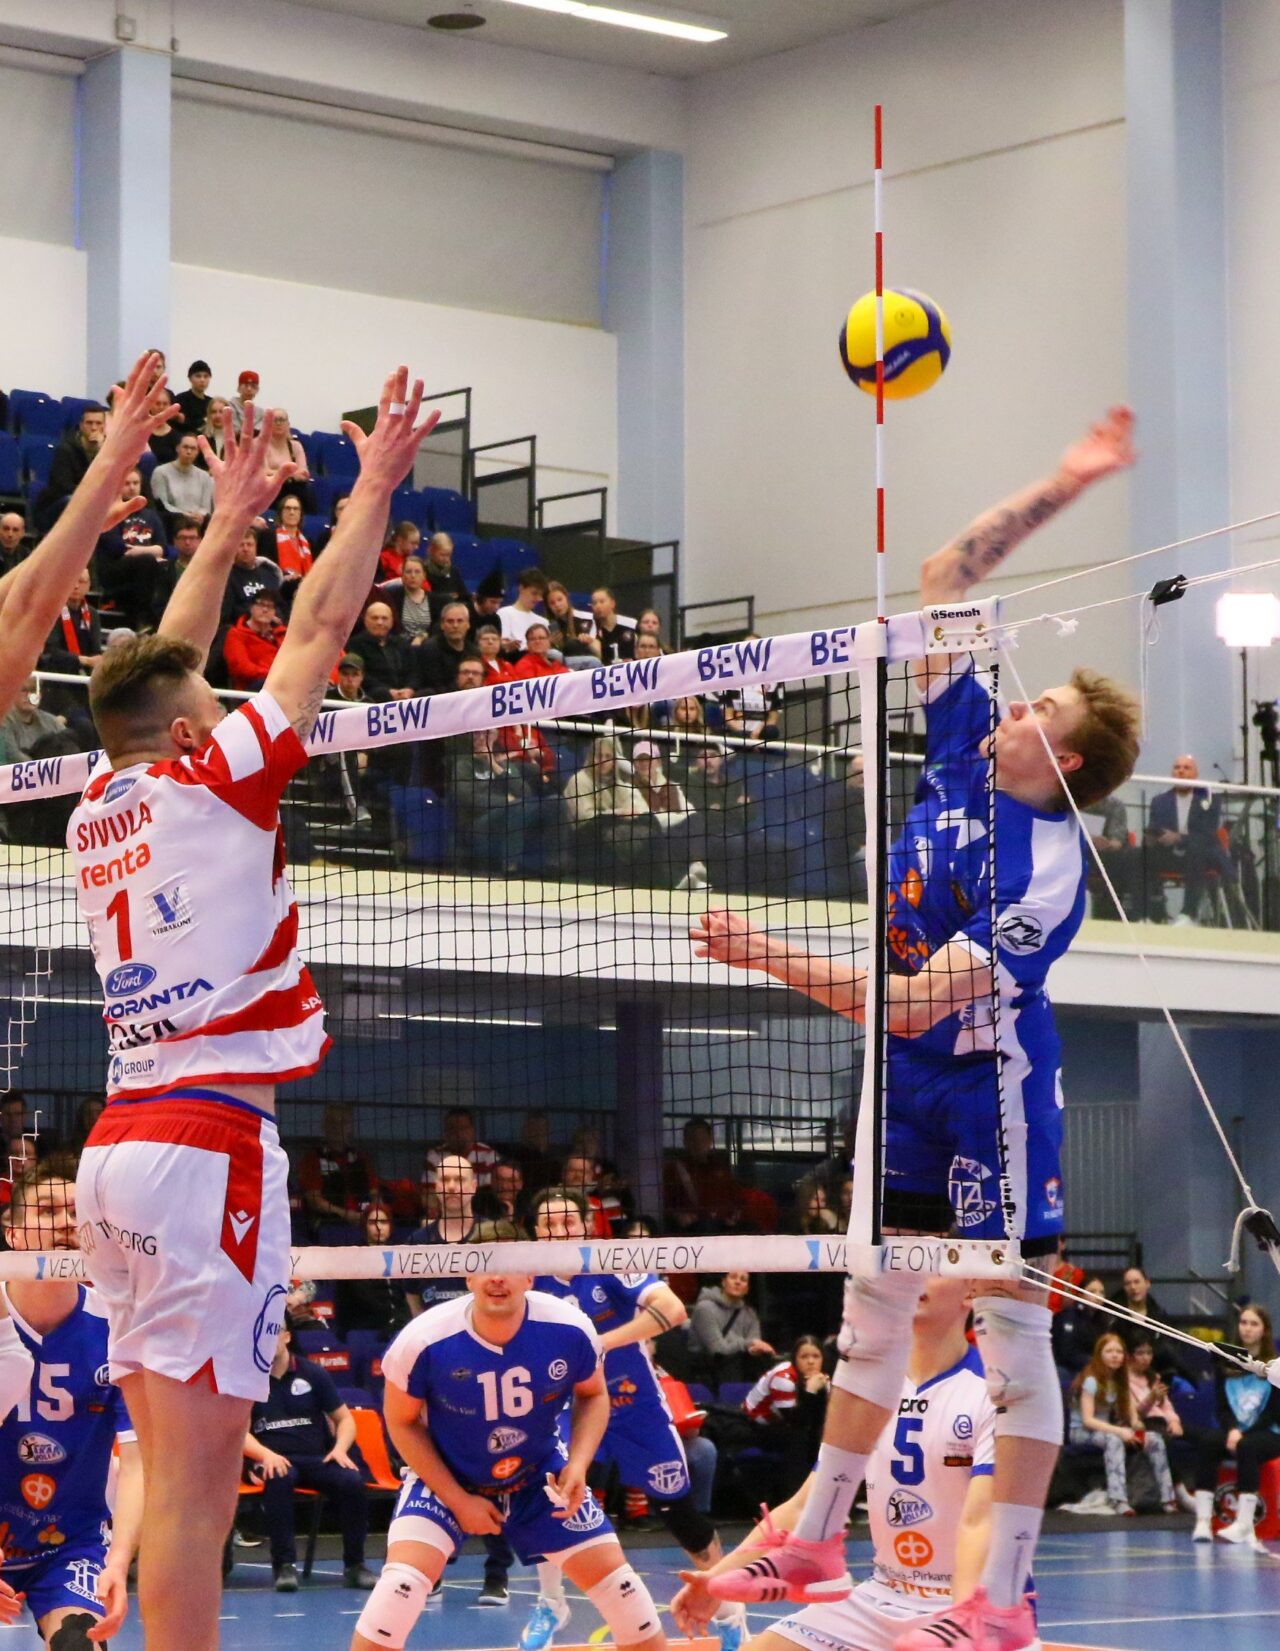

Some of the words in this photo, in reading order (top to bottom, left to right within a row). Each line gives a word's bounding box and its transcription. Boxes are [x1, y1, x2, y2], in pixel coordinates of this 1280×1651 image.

[367, 697, 432, 737] BEWI
[491, 675, 560, 718] BEWI
[591, 657, 661, 700] BEWI
[697, 638, 773, 682] BEWI
[11, 757, 63, 791] BEWI
[77, 801, 153, 852] SIVULA
[81, 842, 151, 888] renta
[106, 888, 132, 962] 1
[111, 968, 143, 993] Ford
[124, 1059, 155, 1075] GROUP
[477, 1366, 533, 1422] 16
[891, 1417, 925, 1486] 5
[406, 1500, 446, 1518] AKAAN
